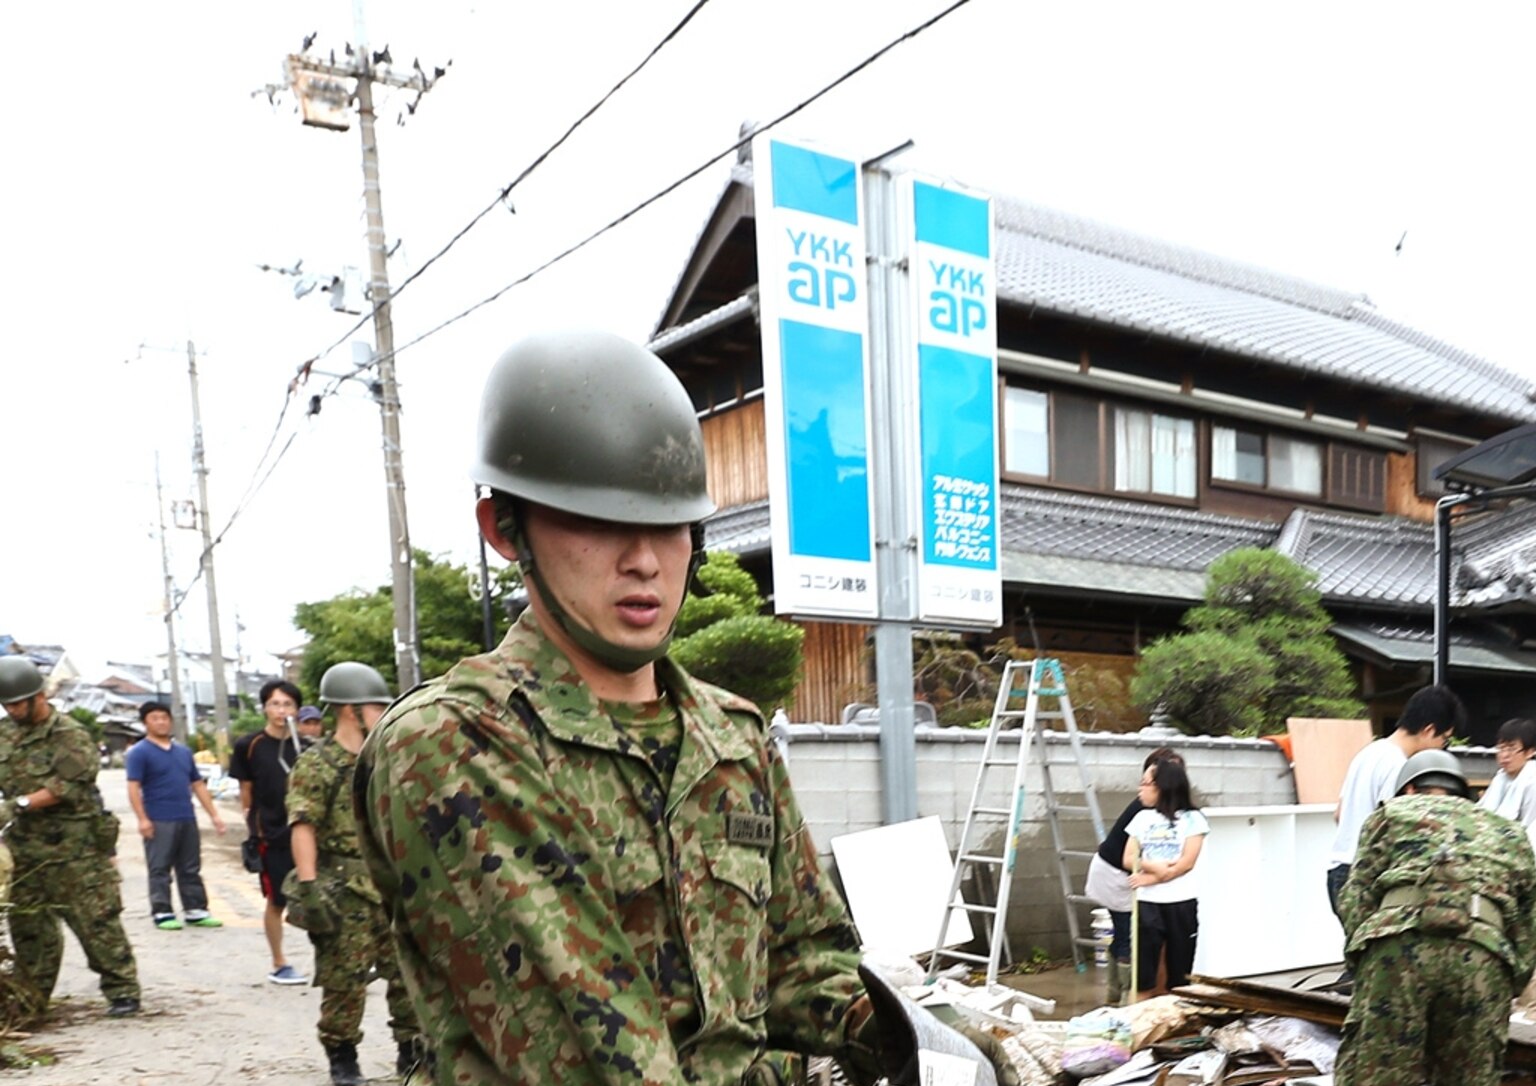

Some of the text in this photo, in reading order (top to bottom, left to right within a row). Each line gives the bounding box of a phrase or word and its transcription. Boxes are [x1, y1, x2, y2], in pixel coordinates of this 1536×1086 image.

[786, 227, 853, 268] YKK
[788, 261, 856, 310] ap
[929, 260, 984, 297] YKK
[929, 291, 986, 337] ap
